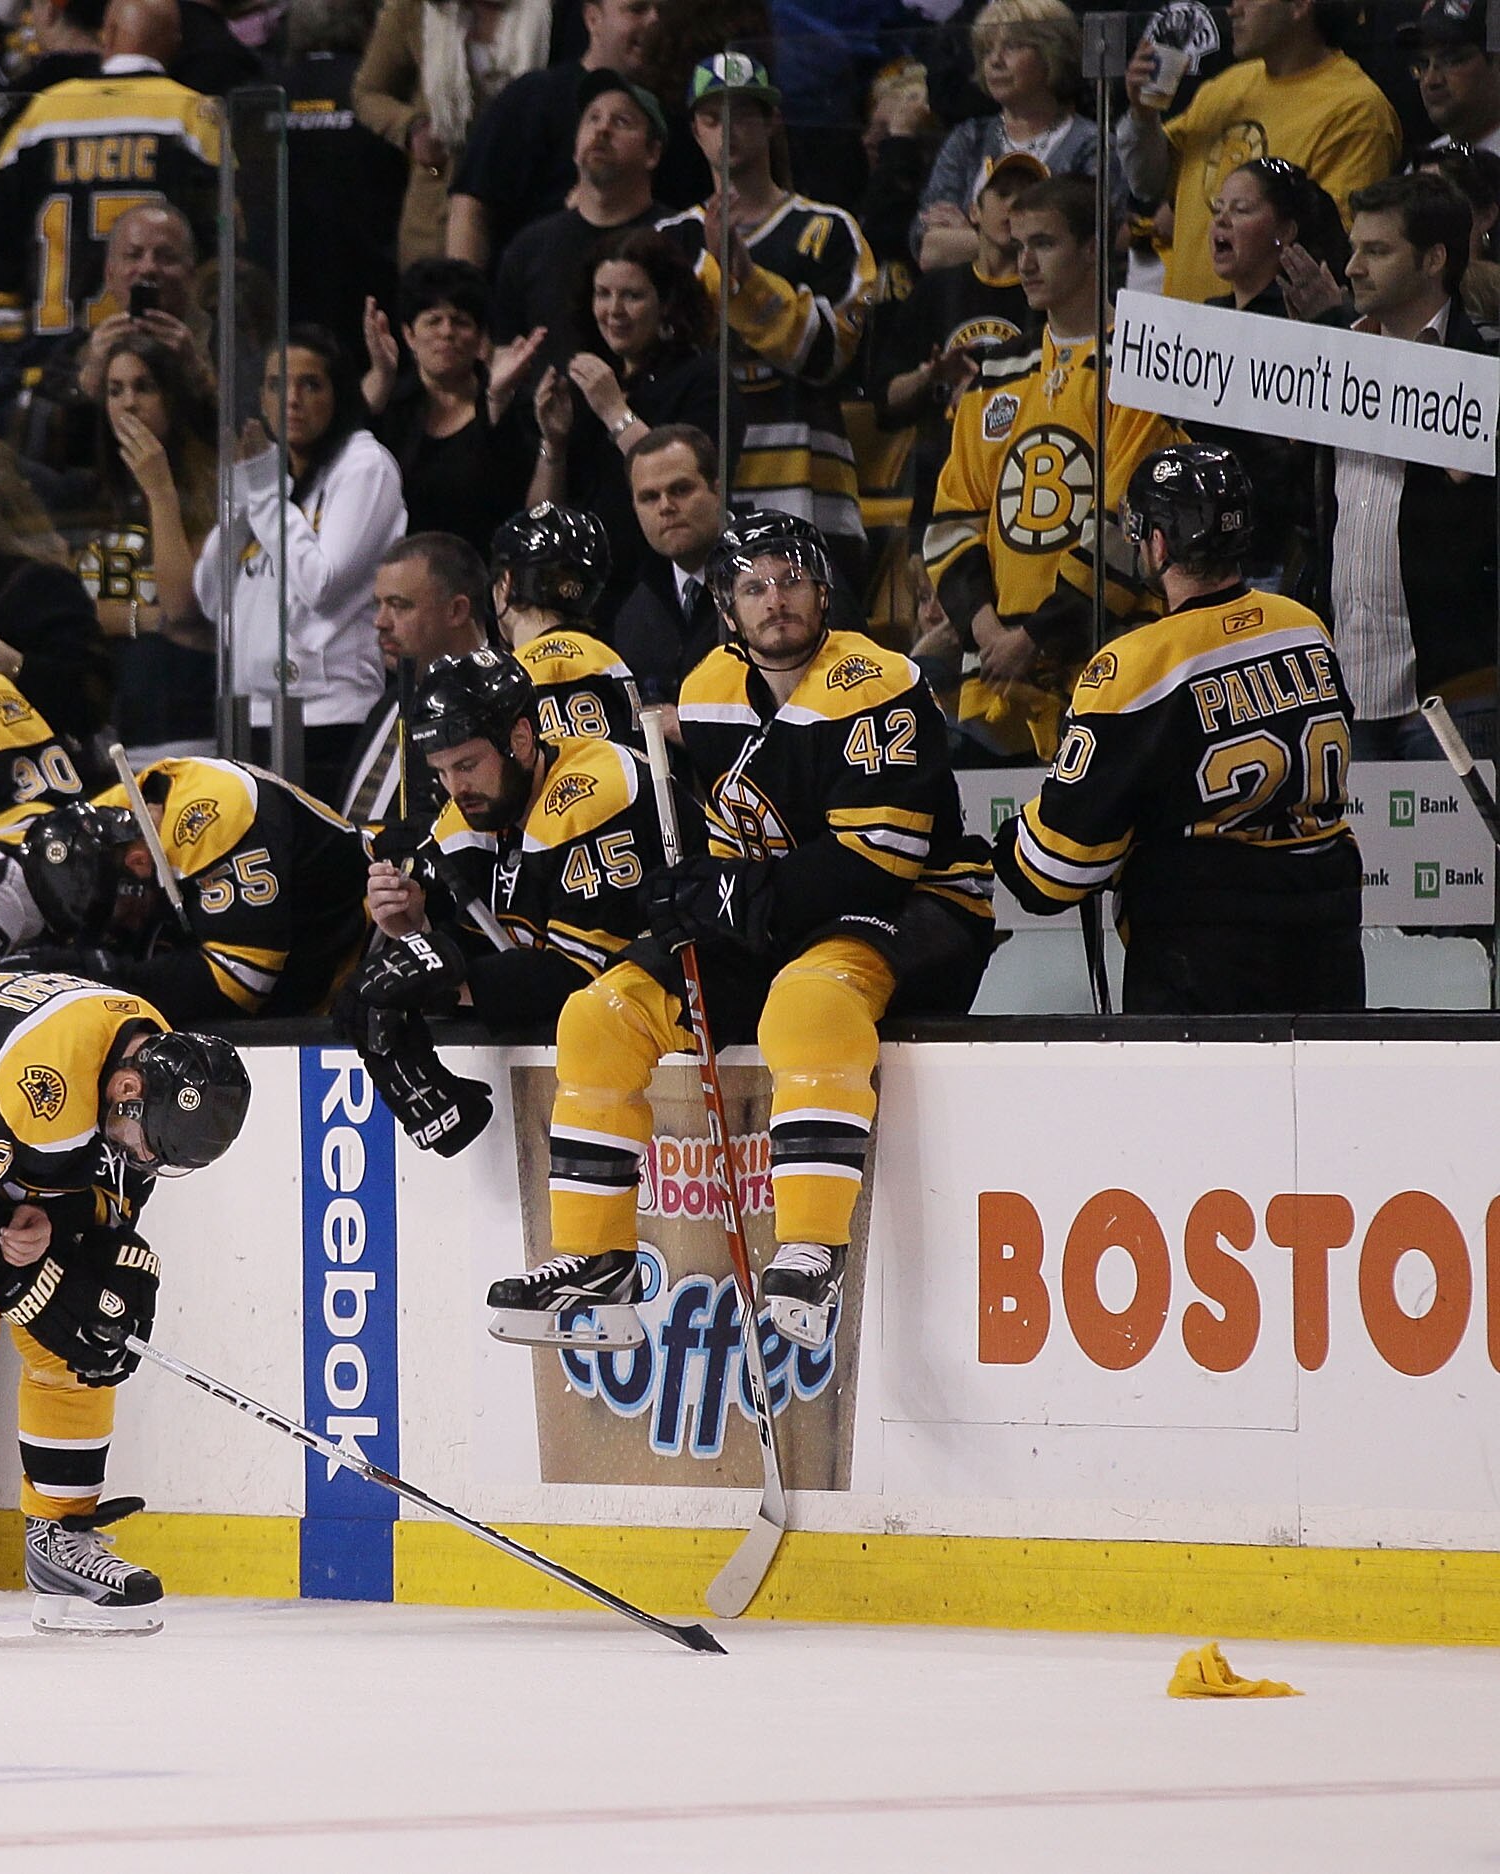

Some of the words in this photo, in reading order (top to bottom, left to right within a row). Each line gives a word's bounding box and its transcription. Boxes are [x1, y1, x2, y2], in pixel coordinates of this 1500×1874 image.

[54, 135, 159, 184] LUCIC
[797, 215, 834, 261] A
[1120, 319, 1235, 407] History
[1250, 355, 1332, 412] won't
[1341, 361, 1382, 420] be
[1390, 381, 1490, 442] made.
[1016, 444, 1073, 531] B
[1220, 510, 1245, 533] 20
[538, 690, 611, 742] 48
[1190, 648, 1338, 735] PAILLE
[843, 707, 918, 775] 42
[1047, 725, 1097, 785] 0
[13, 744, 83, 803] 30
[1196, 711, 1353, 840] 20
[1392, 797, 1413, 820] TD
[1420, 796, 1459, 813] Bank
[201, 847, 279, 914] 55
[561, 830, 643, 900] 45
[1363, 868, 1389, 886] ank
[1417, 869, 1438, 892] TD
[1445, 868, 1484, 885] Bank
[840, 914, 899, 936] Reebok
[30, 1069, 64, 1114] BRUINS
[320, 1050, 379, 1481] Reebok
[977, 1188, 1500, 1377] BOSTO
